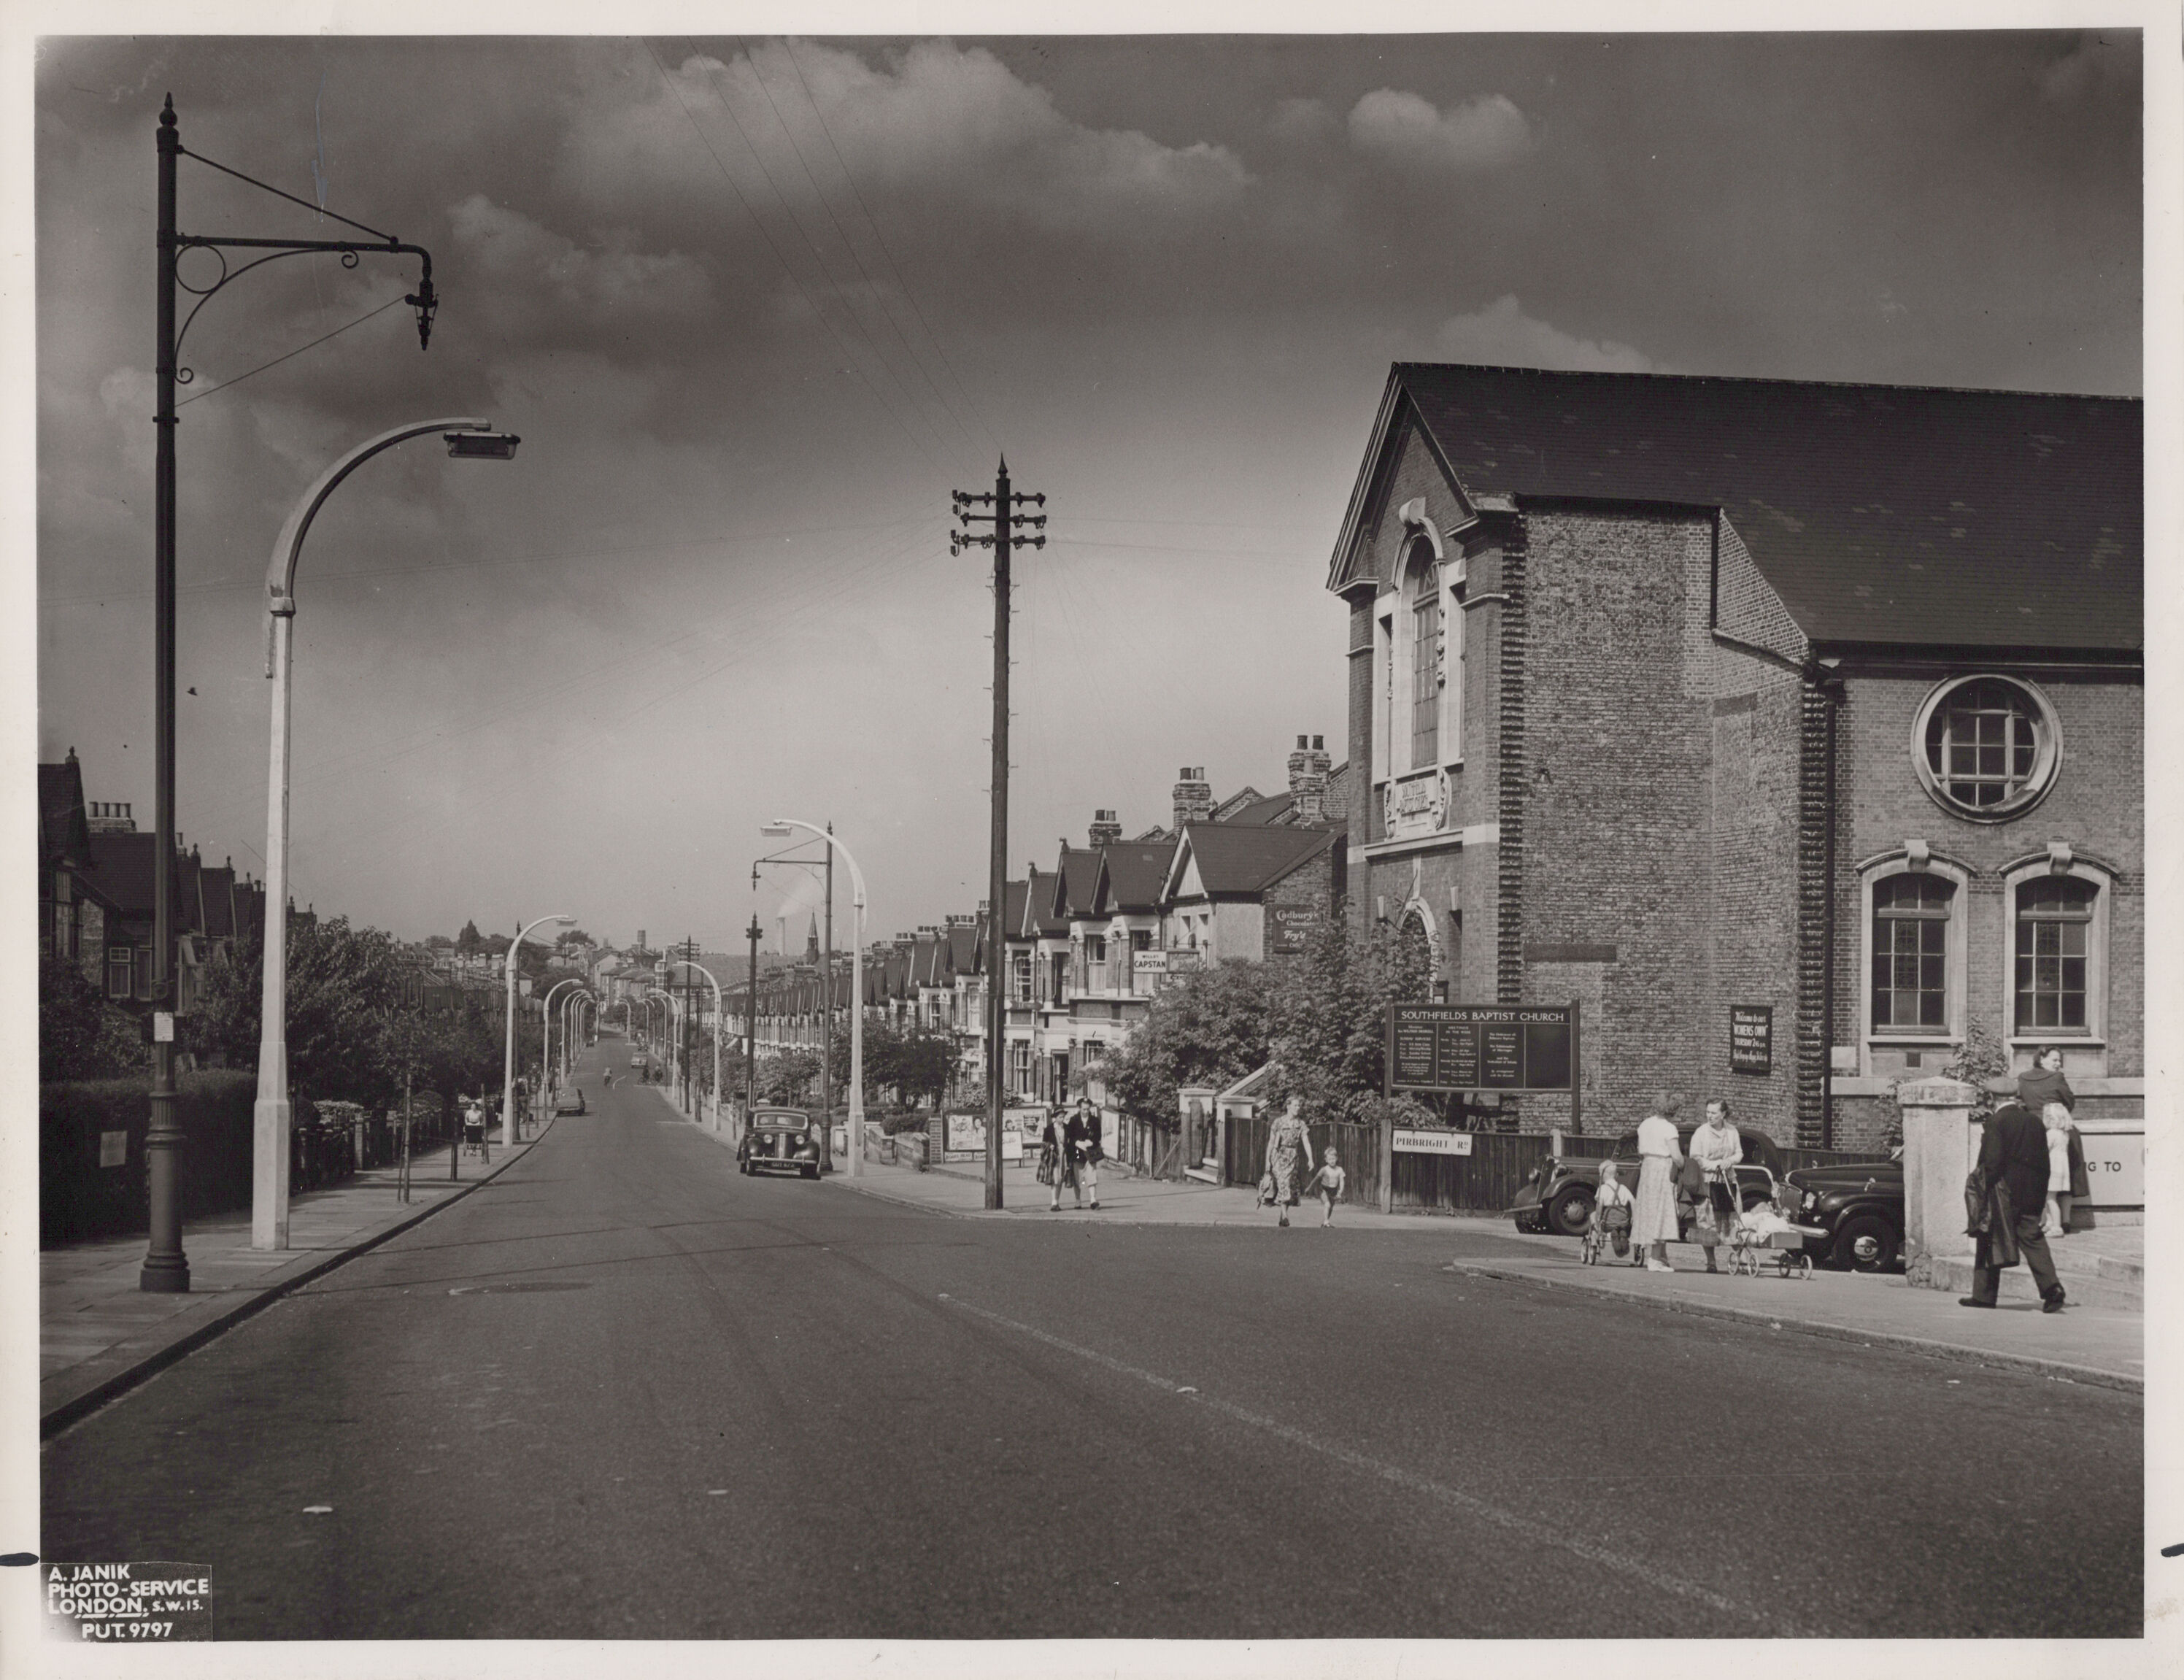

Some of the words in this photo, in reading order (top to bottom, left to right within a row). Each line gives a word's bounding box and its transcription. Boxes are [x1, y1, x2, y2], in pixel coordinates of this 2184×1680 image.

[1284, 930, 1306, 941] Fry's
[1401, 1011, 1467, 1020] SOUTHFIELDS
[1472, 1012, 1515, 1021] BAPTIST
[1520, 1012, 1564, 1022] CHURCH
[1396, 1137, 1448, 1148] PIRBRIGHT
[2104, 1161, 2121, 1172] TO
